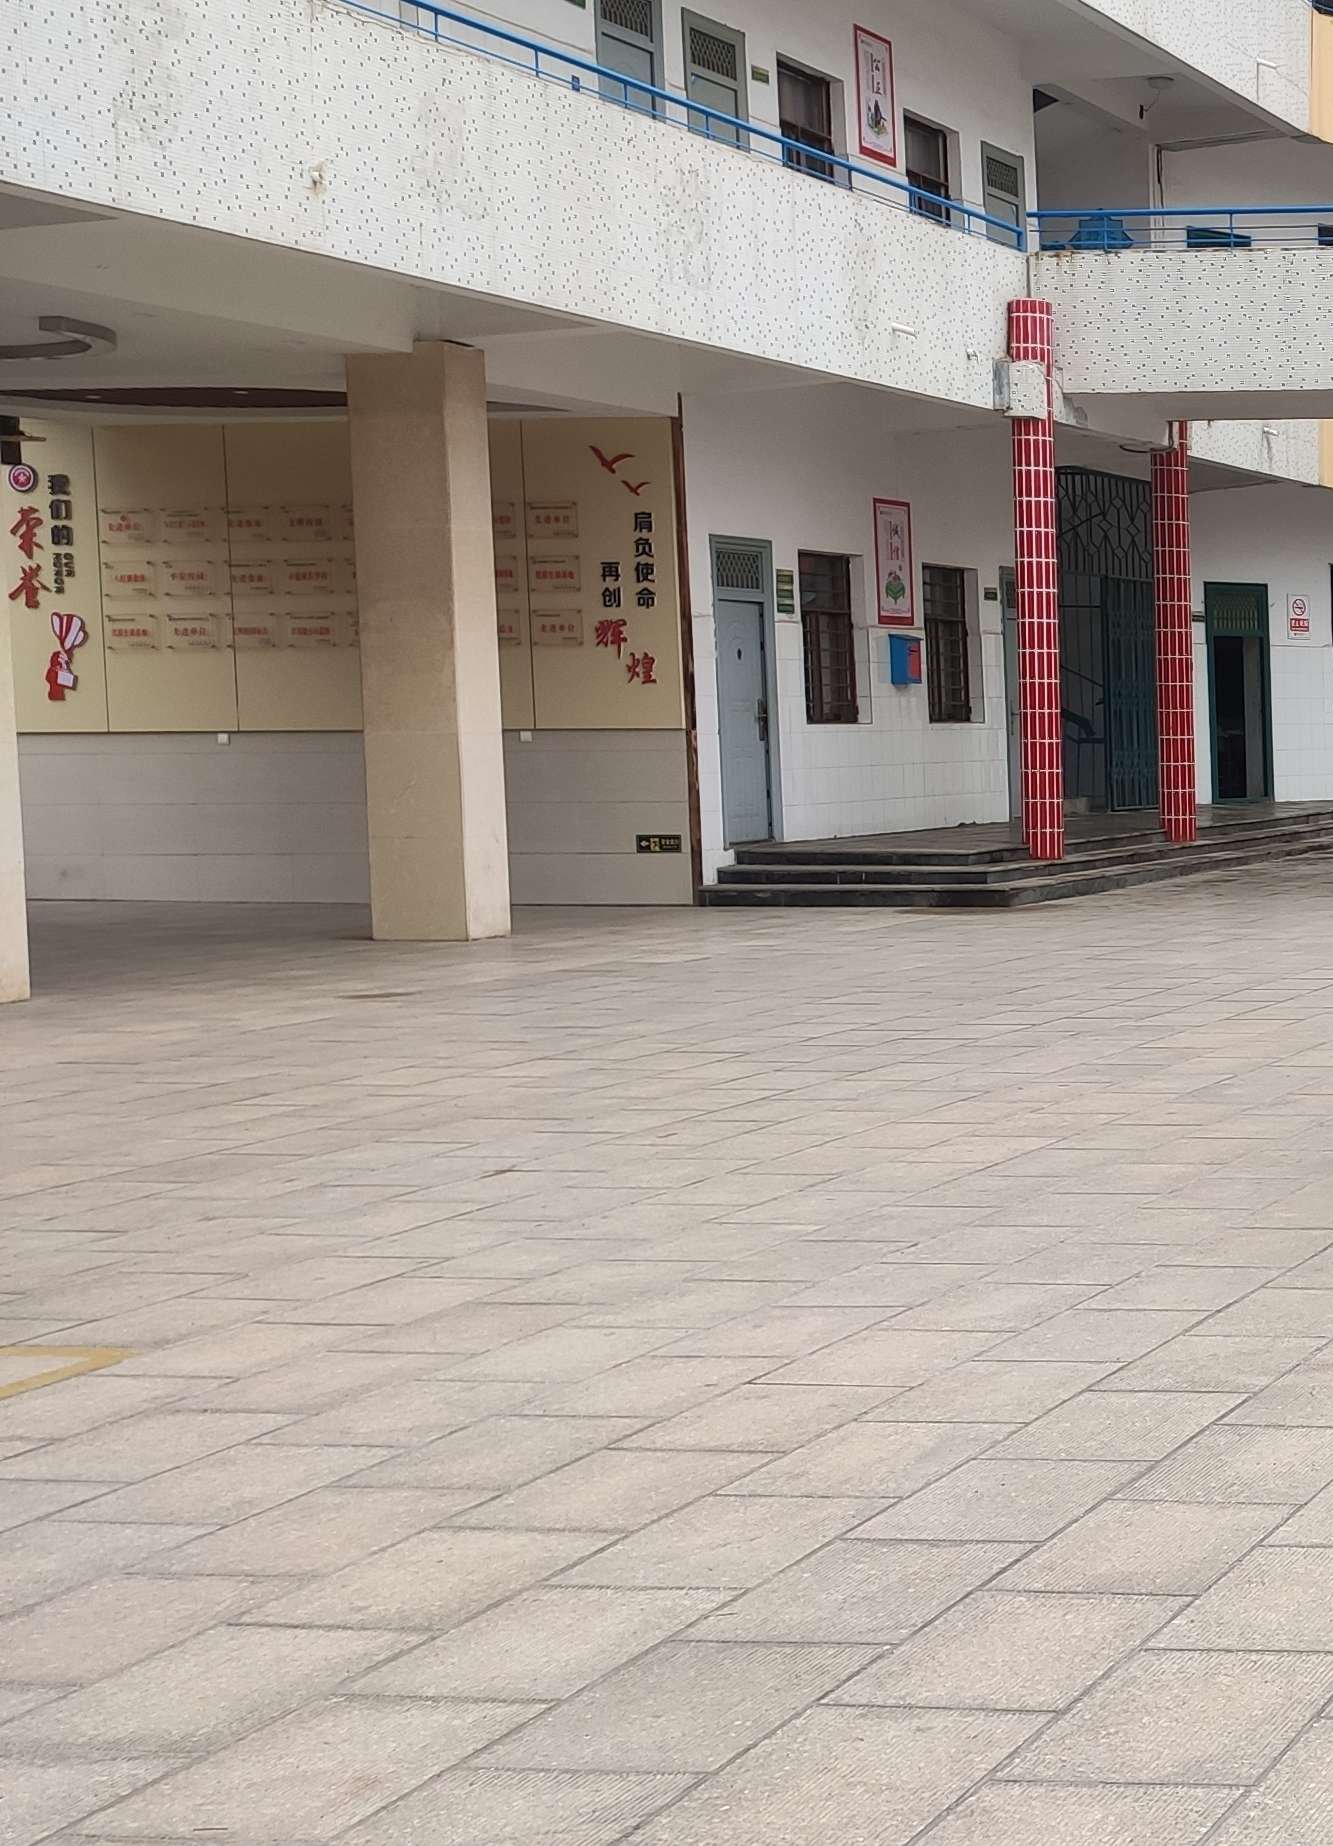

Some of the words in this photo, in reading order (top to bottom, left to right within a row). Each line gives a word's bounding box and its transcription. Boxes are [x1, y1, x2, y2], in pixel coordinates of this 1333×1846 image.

[601, 561, 622, 608] 再创
[634, 511, 657, 609] 肩负使命
[595, 619, 657, 685] 辉煌
